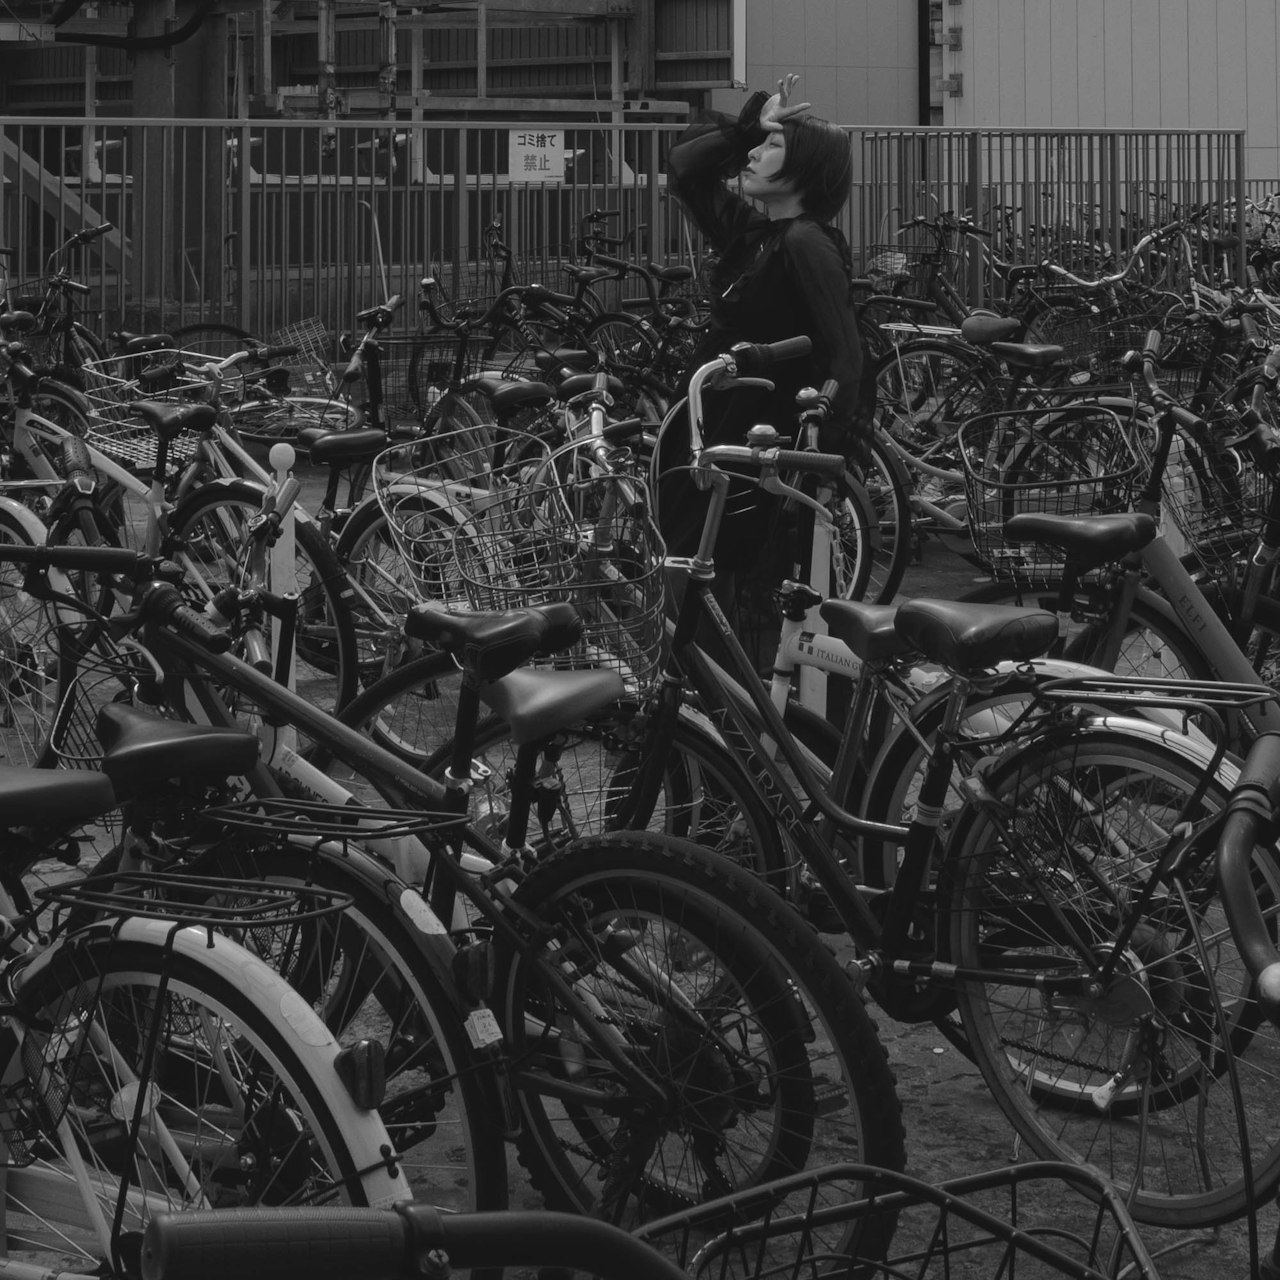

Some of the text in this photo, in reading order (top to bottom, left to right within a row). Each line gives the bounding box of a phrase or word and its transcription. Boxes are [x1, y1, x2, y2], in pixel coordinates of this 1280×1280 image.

[517, 133, 557, 148] ゴミ捨て
[523, 154, 551, 172] 禁止
[816, 648, 851, 669] ITALIAN
